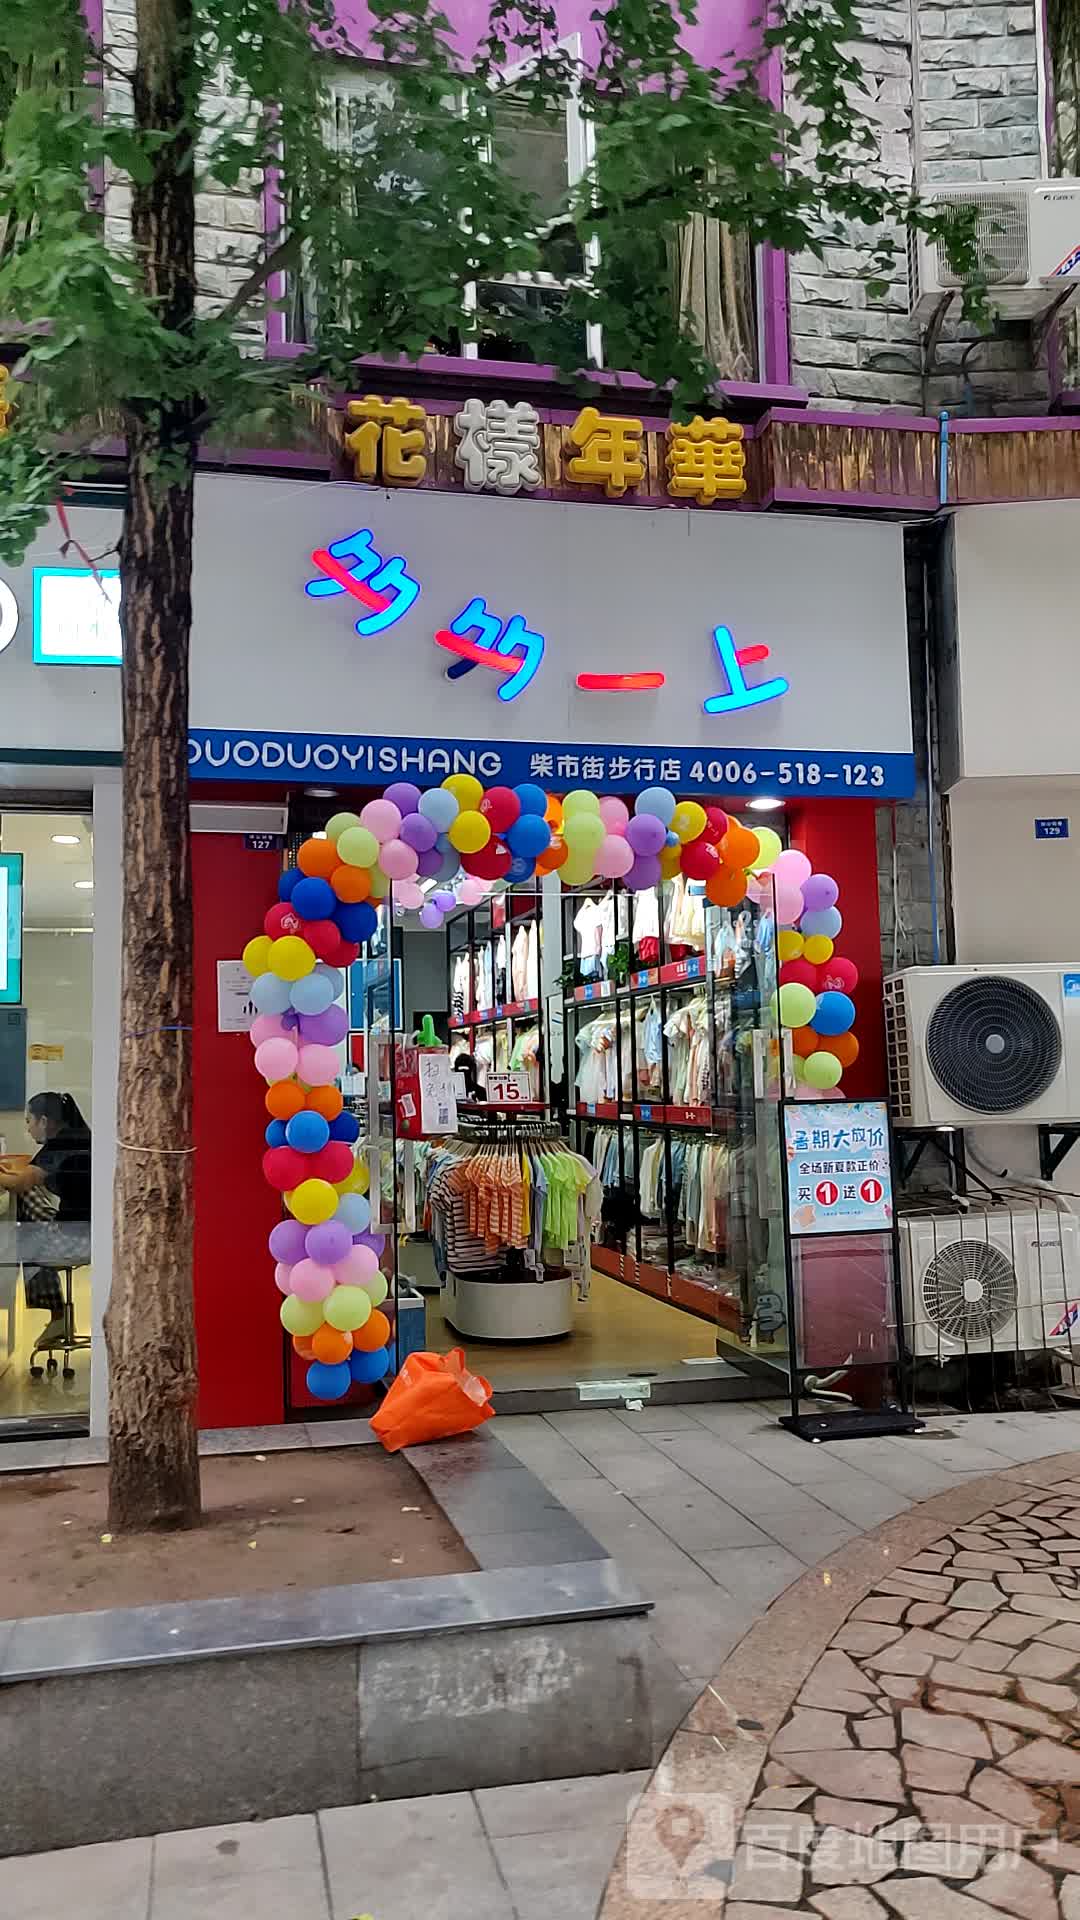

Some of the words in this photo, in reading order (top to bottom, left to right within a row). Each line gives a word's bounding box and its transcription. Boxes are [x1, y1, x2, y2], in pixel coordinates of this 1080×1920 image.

[344, 395, 747, 505] 花樣年華
[529, 753, 681, 782] 柴市街步行店
[689, 760, 885, 787] 4006-518-123
[1044, 827, 1061, 835] 129
[252, 840, 270, 849] 127
[493, 1083, 520, 1100] 15
[794, 1127, 884, 1151] 暑期大放价
[799, 1160, 879, 1175] 全场新夏款正价
